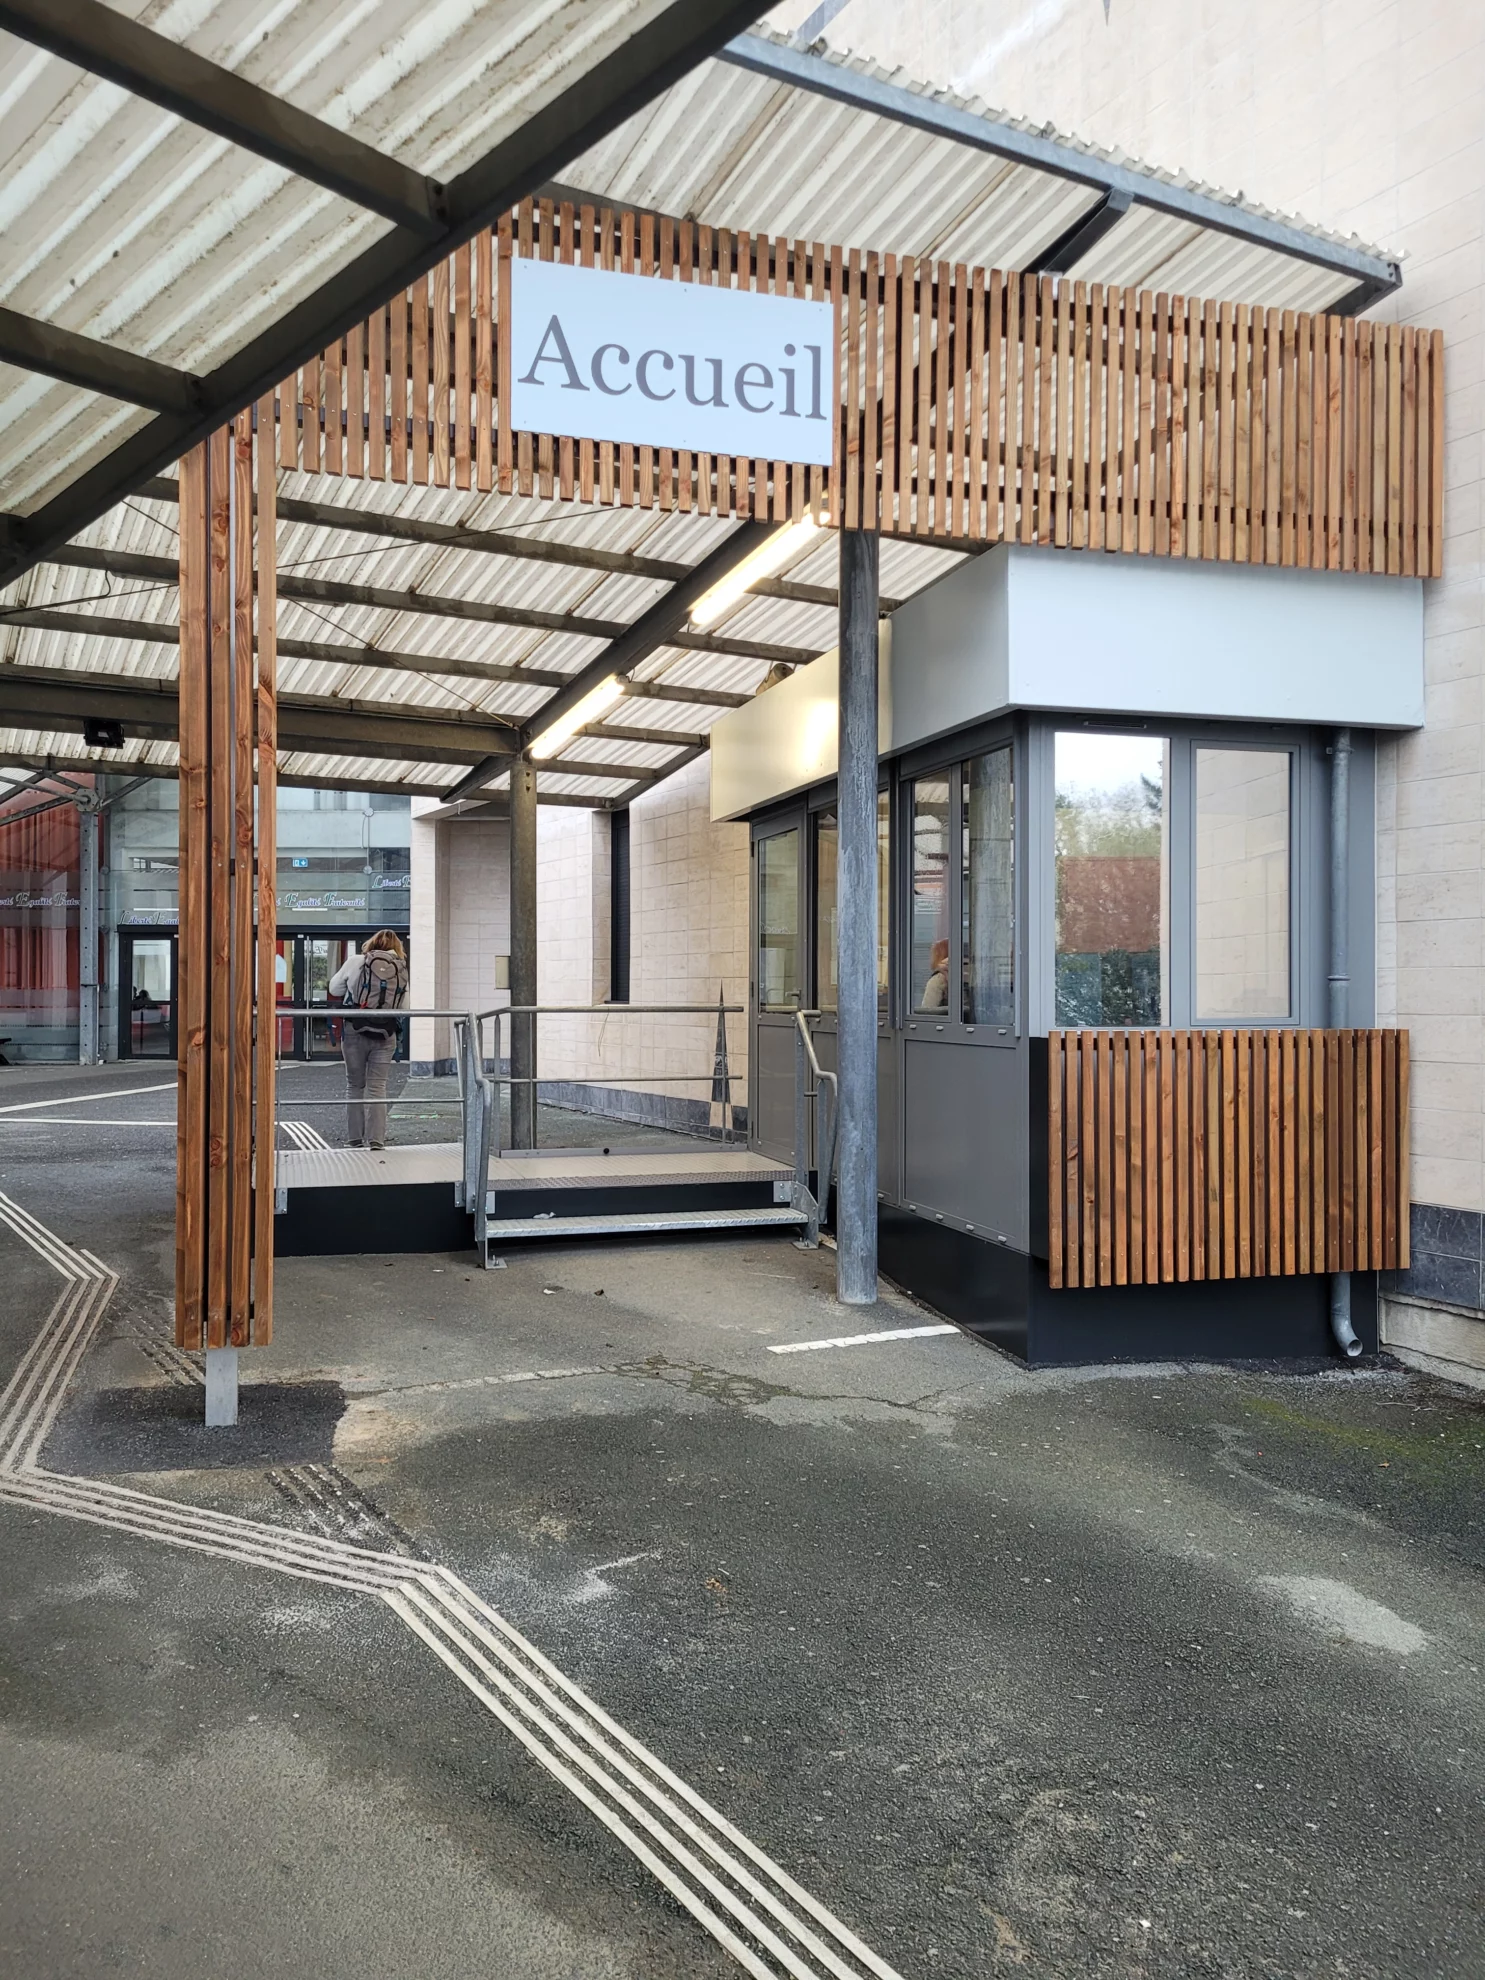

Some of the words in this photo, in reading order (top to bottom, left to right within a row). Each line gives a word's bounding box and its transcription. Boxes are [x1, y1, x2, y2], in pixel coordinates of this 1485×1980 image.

[517, 314, 827, 420] Accueil
[372, 875, 402, 888] Liberté
[285, 892, 321, 908] Egalité
[324, 892, 365, 907] Fraternité
